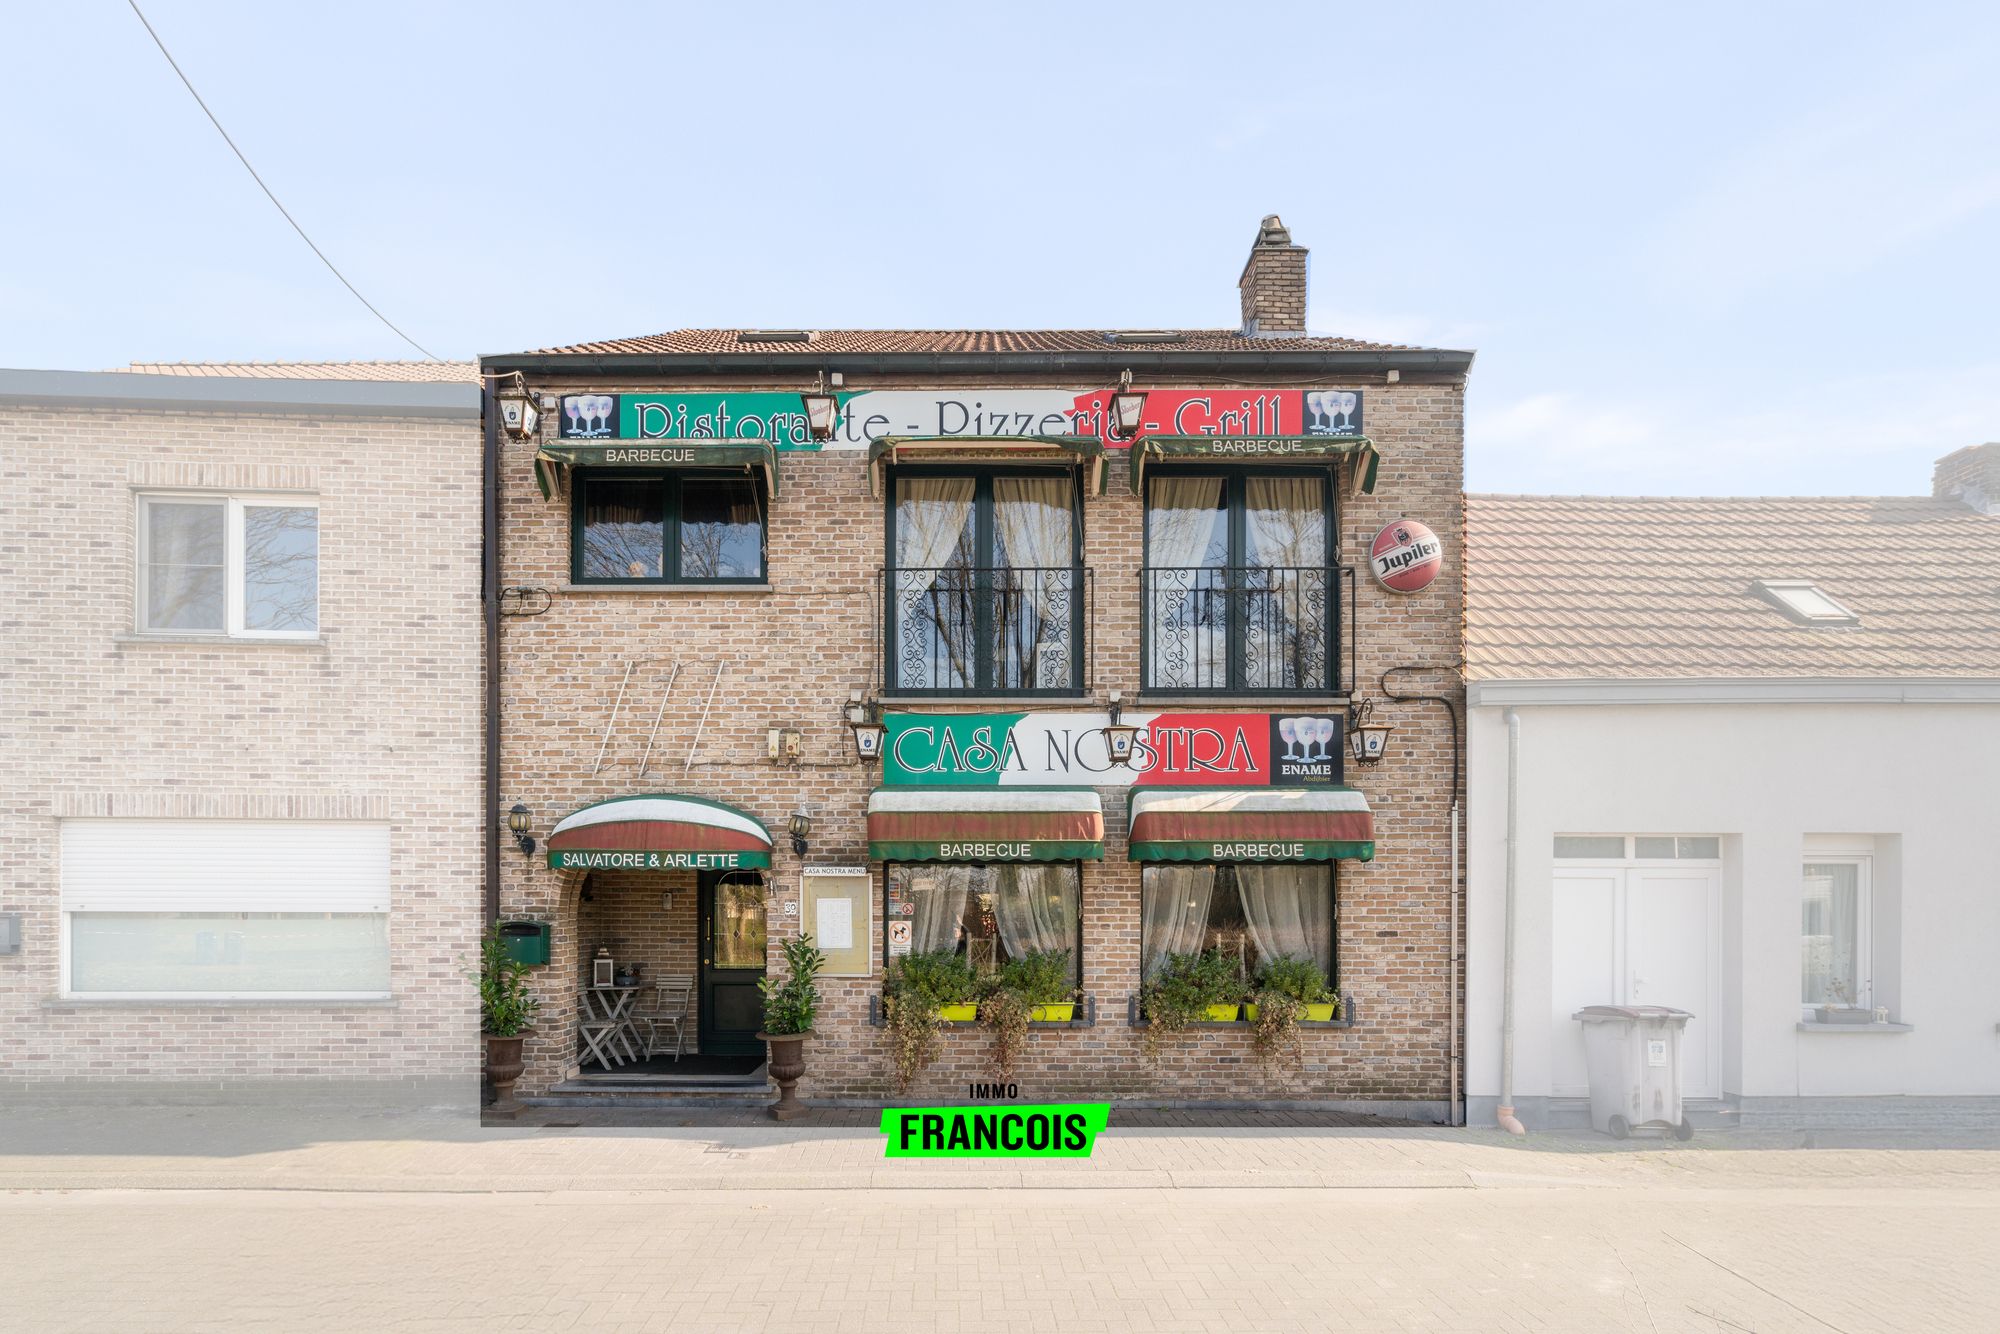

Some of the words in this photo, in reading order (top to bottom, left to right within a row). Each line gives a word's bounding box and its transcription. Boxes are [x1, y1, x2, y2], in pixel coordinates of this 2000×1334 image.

[1174, 394, 1281, 436] Grill
[1212, 440, 1302, 453] BARBECUE
[605, 449, 696, 462] BARBECUE
[1378, 542, 1438, 575] Jupiler
[893, 726, 1028, 773] CASA
[1044, 726, 1259, 774] NOSTRA
[1281, 764, 1332, 775] ENAME
[939, 843, 1032, 857] BARBECUE
[1212, 843, 1305, 857] BARBECUE
[562, 853, 645, 867] SALVATORE
[649, 853, 660, 867] &
[663, 853, 739, 867] ARLETTE
[785, 903, 796, 913] 39
